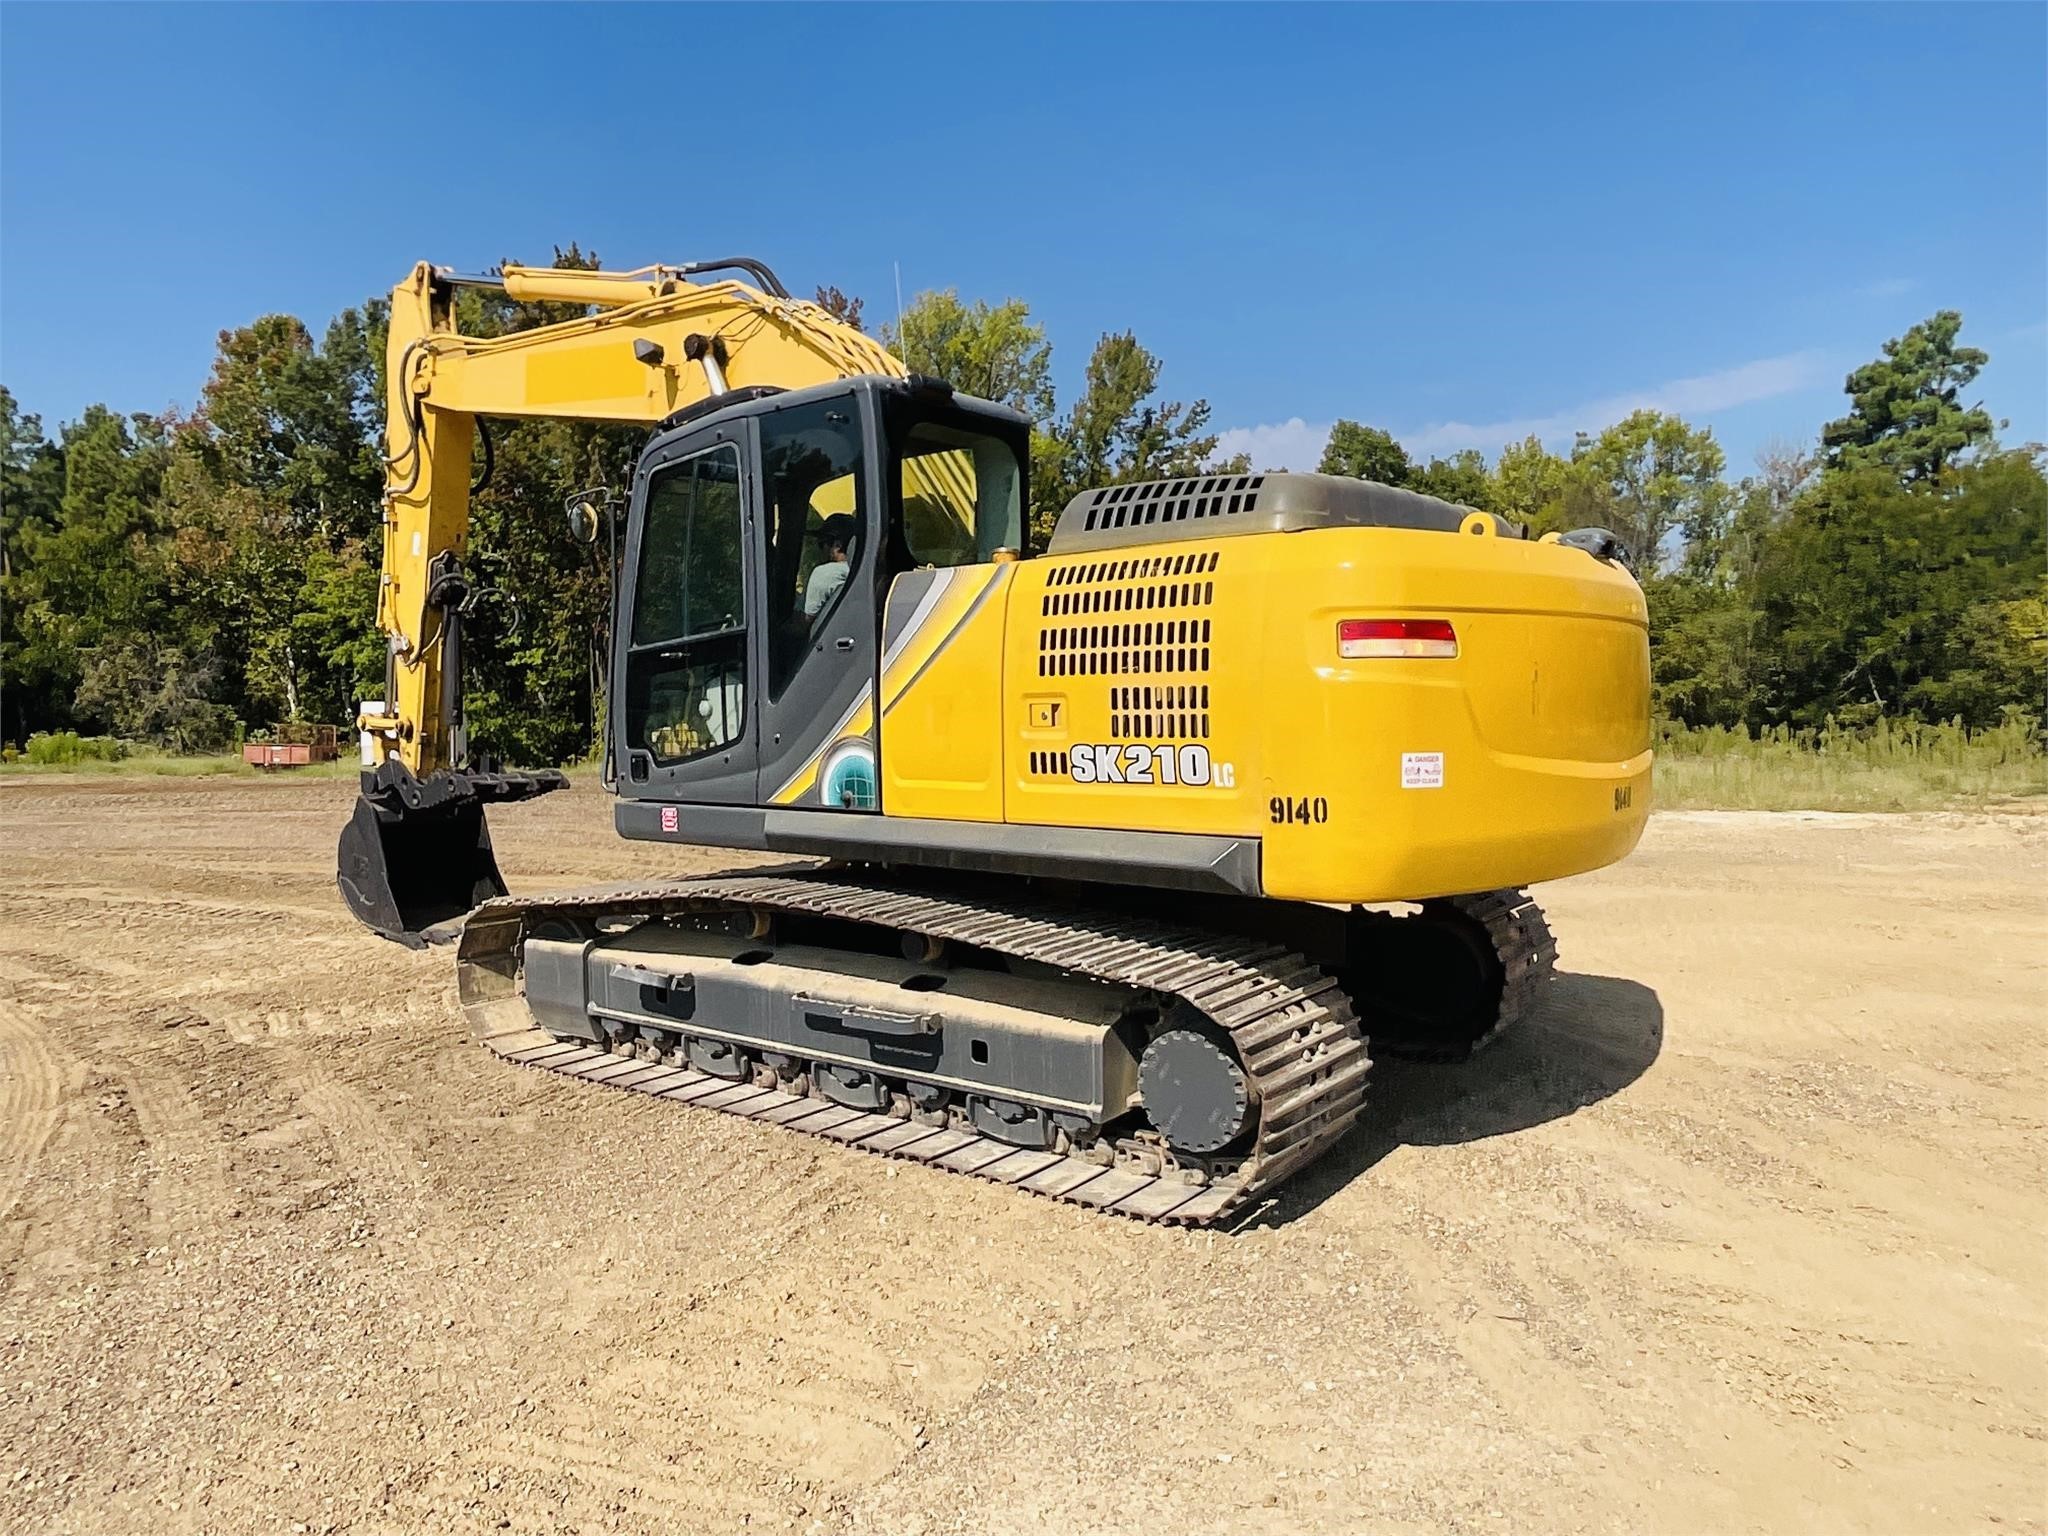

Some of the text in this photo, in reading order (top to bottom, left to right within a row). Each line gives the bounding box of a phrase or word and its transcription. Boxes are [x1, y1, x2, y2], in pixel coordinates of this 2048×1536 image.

[1069, 744, 1236, 788] SK210 LC
[1414, 755, 1440, 763] DANGER
[1269, 796, 1328, 825] 9140
